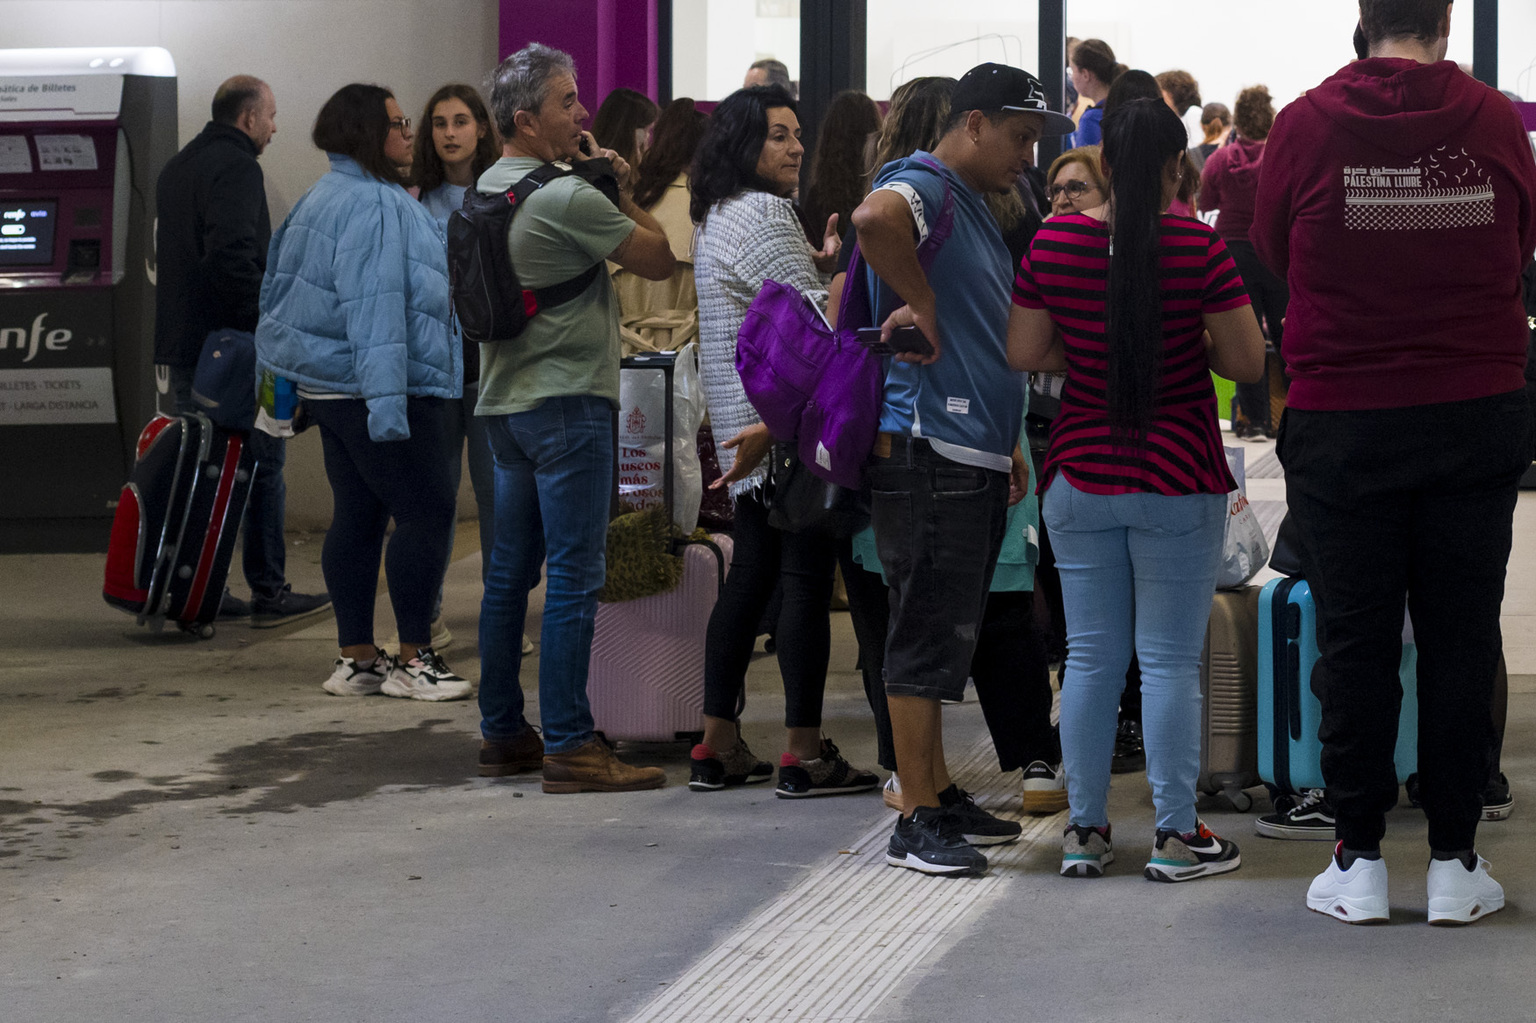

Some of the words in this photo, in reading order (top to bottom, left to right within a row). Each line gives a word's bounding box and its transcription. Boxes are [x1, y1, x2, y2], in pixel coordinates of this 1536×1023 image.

[0, 84, 25, 93] ática
[27, 84, 39, 93] de
[42, 84, 76, 93] Billetes
[1344, 176, 1391, 187] PALESTINA
[1394, 176, 1422, 187] LLIURE
[0, 312, 73, 363] nfe
[0, 381, 37, 391] ILLETES
[622, 447, 646, 458] Los
[620, 474, 648, 485] más
